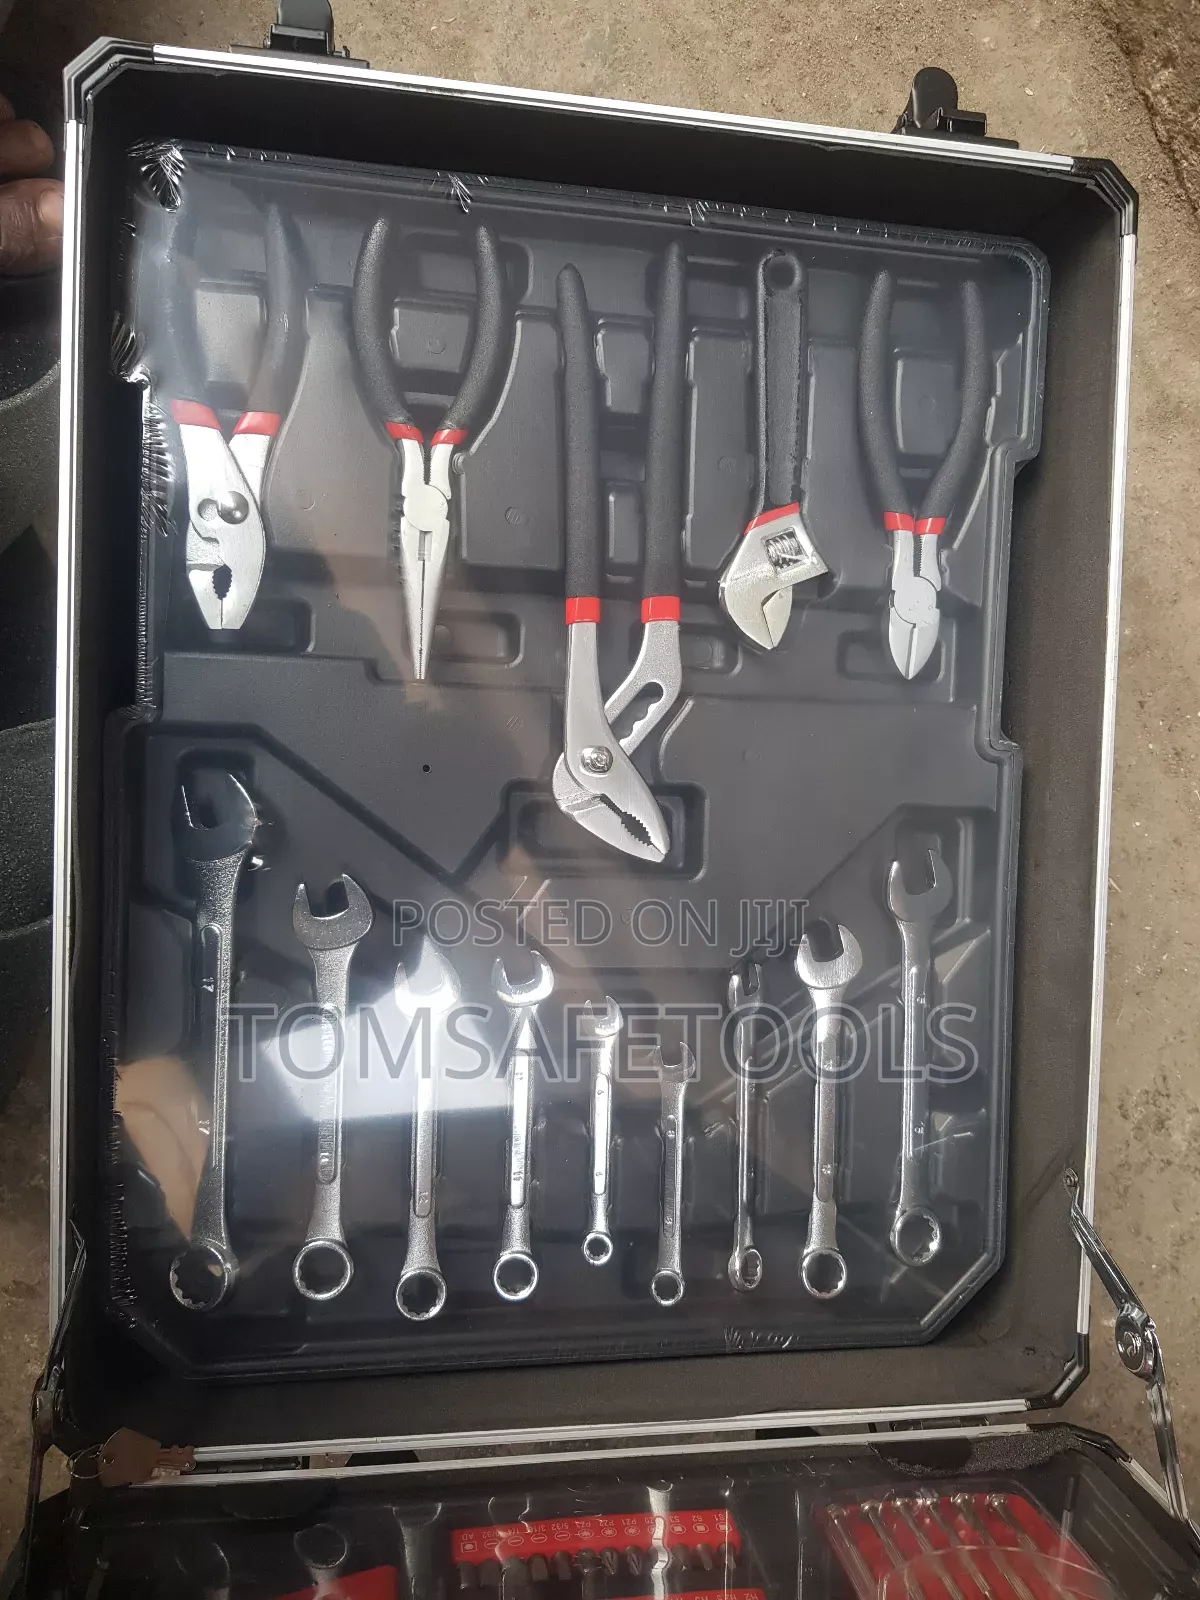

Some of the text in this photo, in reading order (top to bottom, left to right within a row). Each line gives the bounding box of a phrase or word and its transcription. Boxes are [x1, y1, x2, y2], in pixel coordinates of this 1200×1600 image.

[621, 1518, 637, 1526] PZ1
[669, 1515, 680, 1523] S3
[692, 1514, 703, 1522] S2
[551, 1522, 569, 1531] 5/32
[599, 1519, 615, 1527] PZ2
